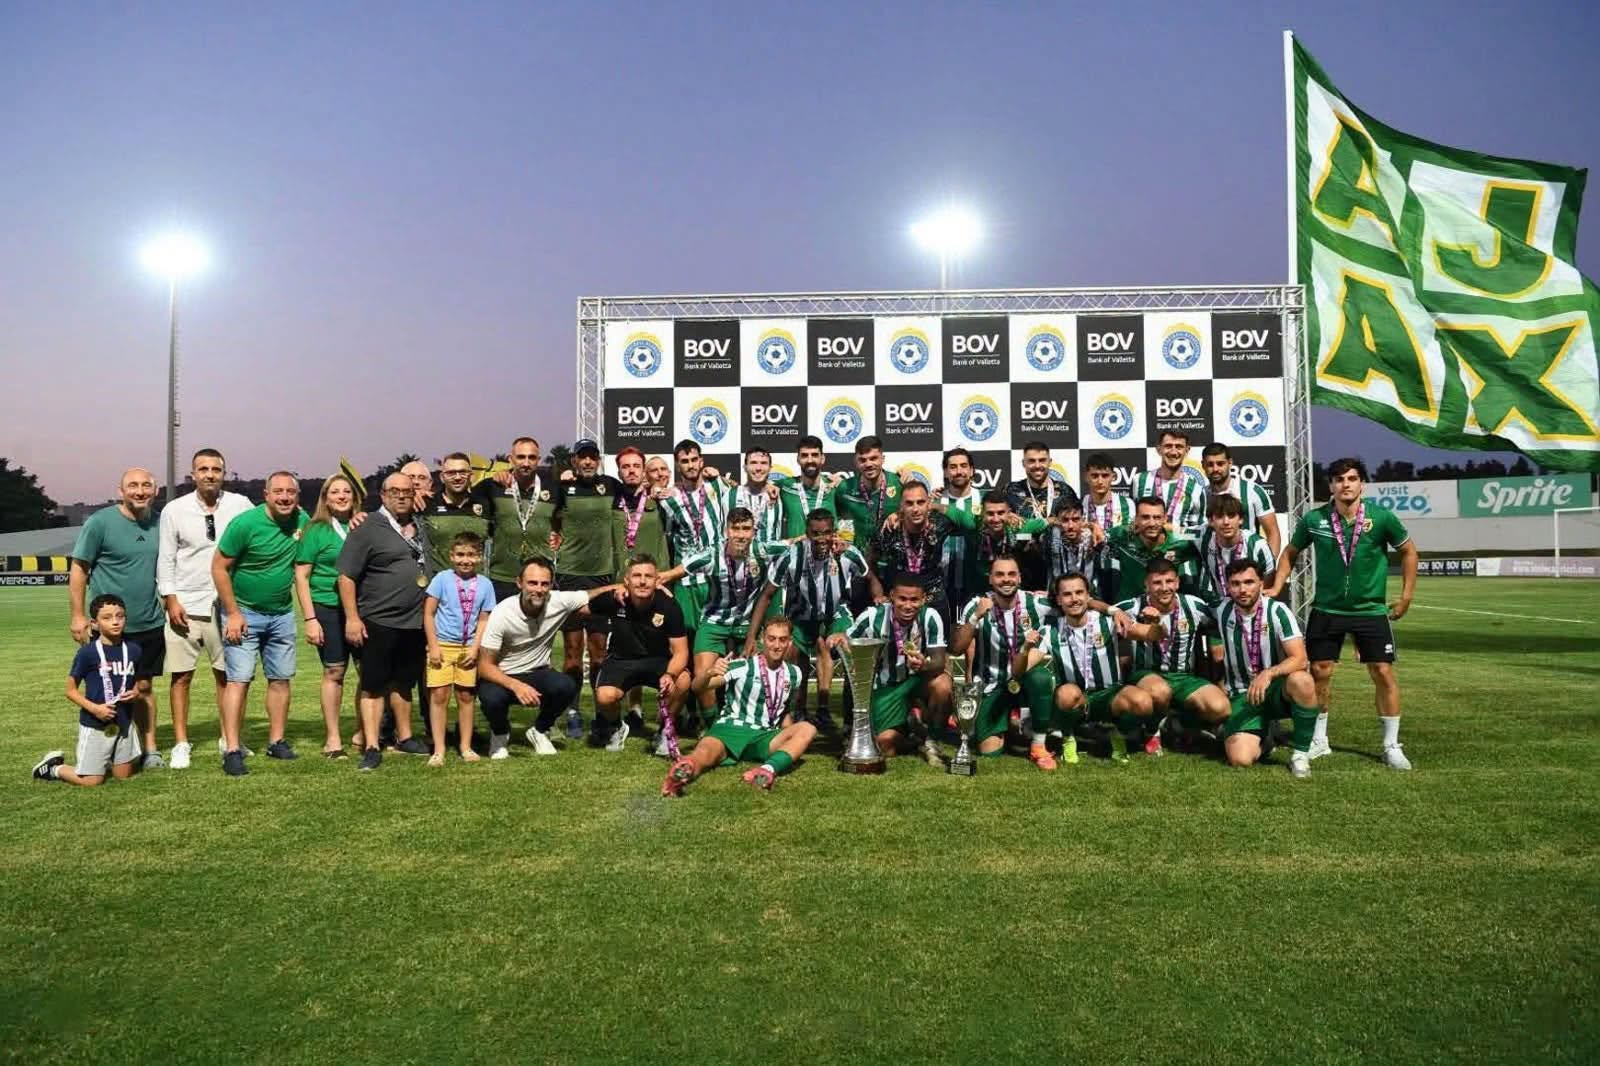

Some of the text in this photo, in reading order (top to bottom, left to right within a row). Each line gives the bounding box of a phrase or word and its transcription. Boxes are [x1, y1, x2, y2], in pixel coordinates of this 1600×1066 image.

[684, 338, 731, 357] BOV
[817, 337, 864, 356] BOV
[952, 334, 999, 354] BOV
[1087, 332, 1134, 351] BOV
[1222, 329, 1269, 349] BOV
[817, 361, 833, 369] Bank
[841, 360, 865, 368] Valletta
[952, 359, 968, 367] Bank
[976, 358, 1000, 366] Valletta
[1222, 354, 1238, 362] Bank
[1246, 353, 1270, 361] Valletta
[617, 406, 664, 425] BOV
[751, 404, 798, 423] BOV
[885, 402, 932, 422] BOV
[1020, 400, 1067, 419] BOV
[1156, 398, 1203, 417] BOV
[617, 430, 633, 438] Bank
[641, 429, 665, 437] Valletta
[751, 428, 767, 436] Bank
[775, 427, 799, 435] Valletta
[885, 427, 901, 435] Bank
[909, 426, 933, 434] Valletta
[1156, 422, 1172, 430] Bank
[1180, 421, 1204, 429] Valletta
[970, 468, 1002, 488] OV
[1110, 466, 1138, 486] OV
[1378, 485, 1409, 496] visit
[1477, 478, 1573, 514] Sprite
[1370, 495, 1427, 511] OZO
